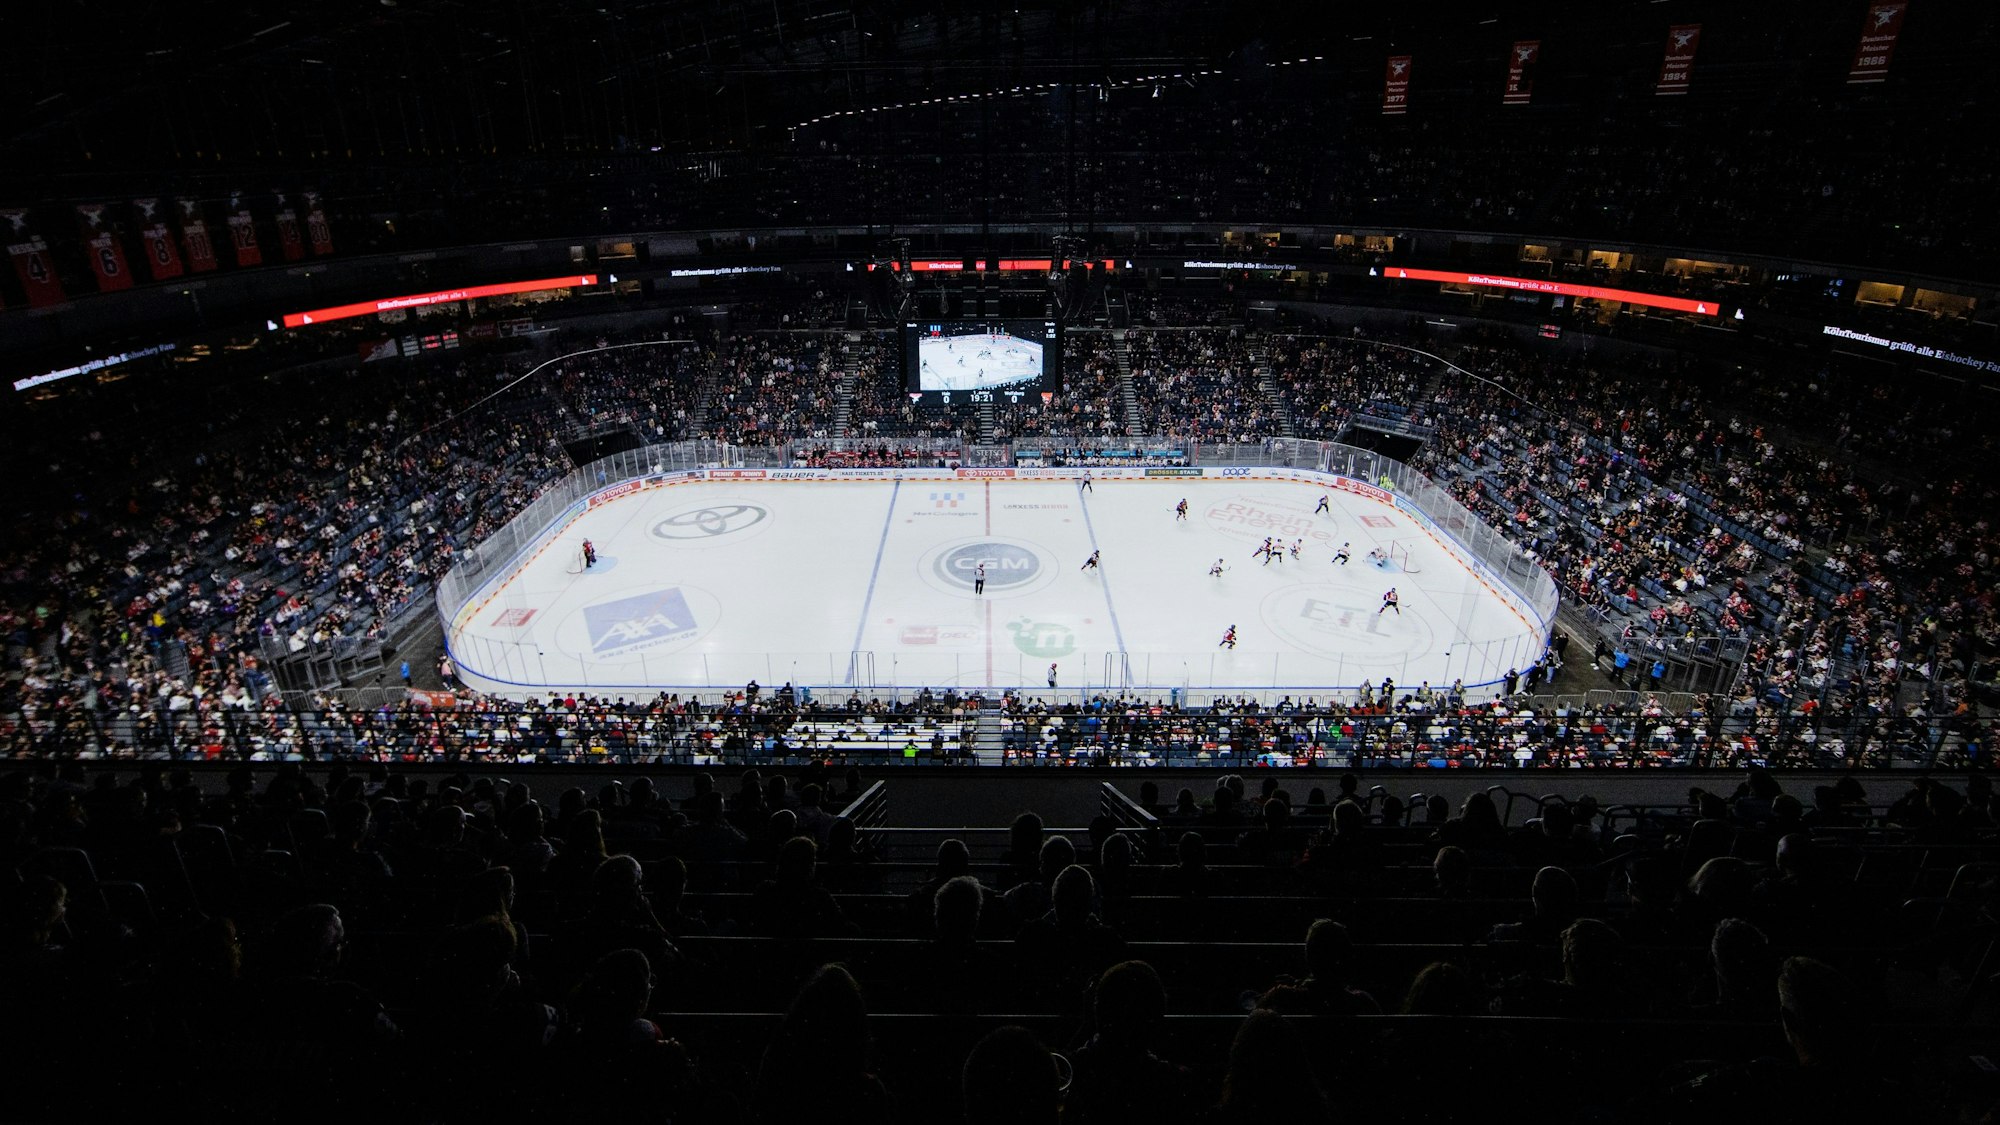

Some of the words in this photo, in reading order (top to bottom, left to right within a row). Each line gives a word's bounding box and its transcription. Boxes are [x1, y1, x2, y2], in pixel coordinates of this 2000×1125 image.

[1386, 94, 1405, 103] 1977
[1468, 276, 1519, 287] KölnTourismus
[1519, 280, 1539, 290] grüßt
[1539, 283, 1553, 291] alle
[1823, 325, 1891, 347] KölnTourismus
[1890, 341, 1917, 353] grüßt
[1916, 345, 1935, 357] alle
[1934, 349, 1986, 371] Eishockey
[943, 396, 950, 404] 0
[970, 394, 993, 402] 19:21
[1011, 396, 1018, 404] 0
[606, 484, 633, 499] TOYOTA
[1358, 483, 1386, 499] TOYOTA
[1225, 503, 1314, 528] Rhein
[1207, 508, 1331, 541] Energie
[954, 557, 1030, 570] CGM
